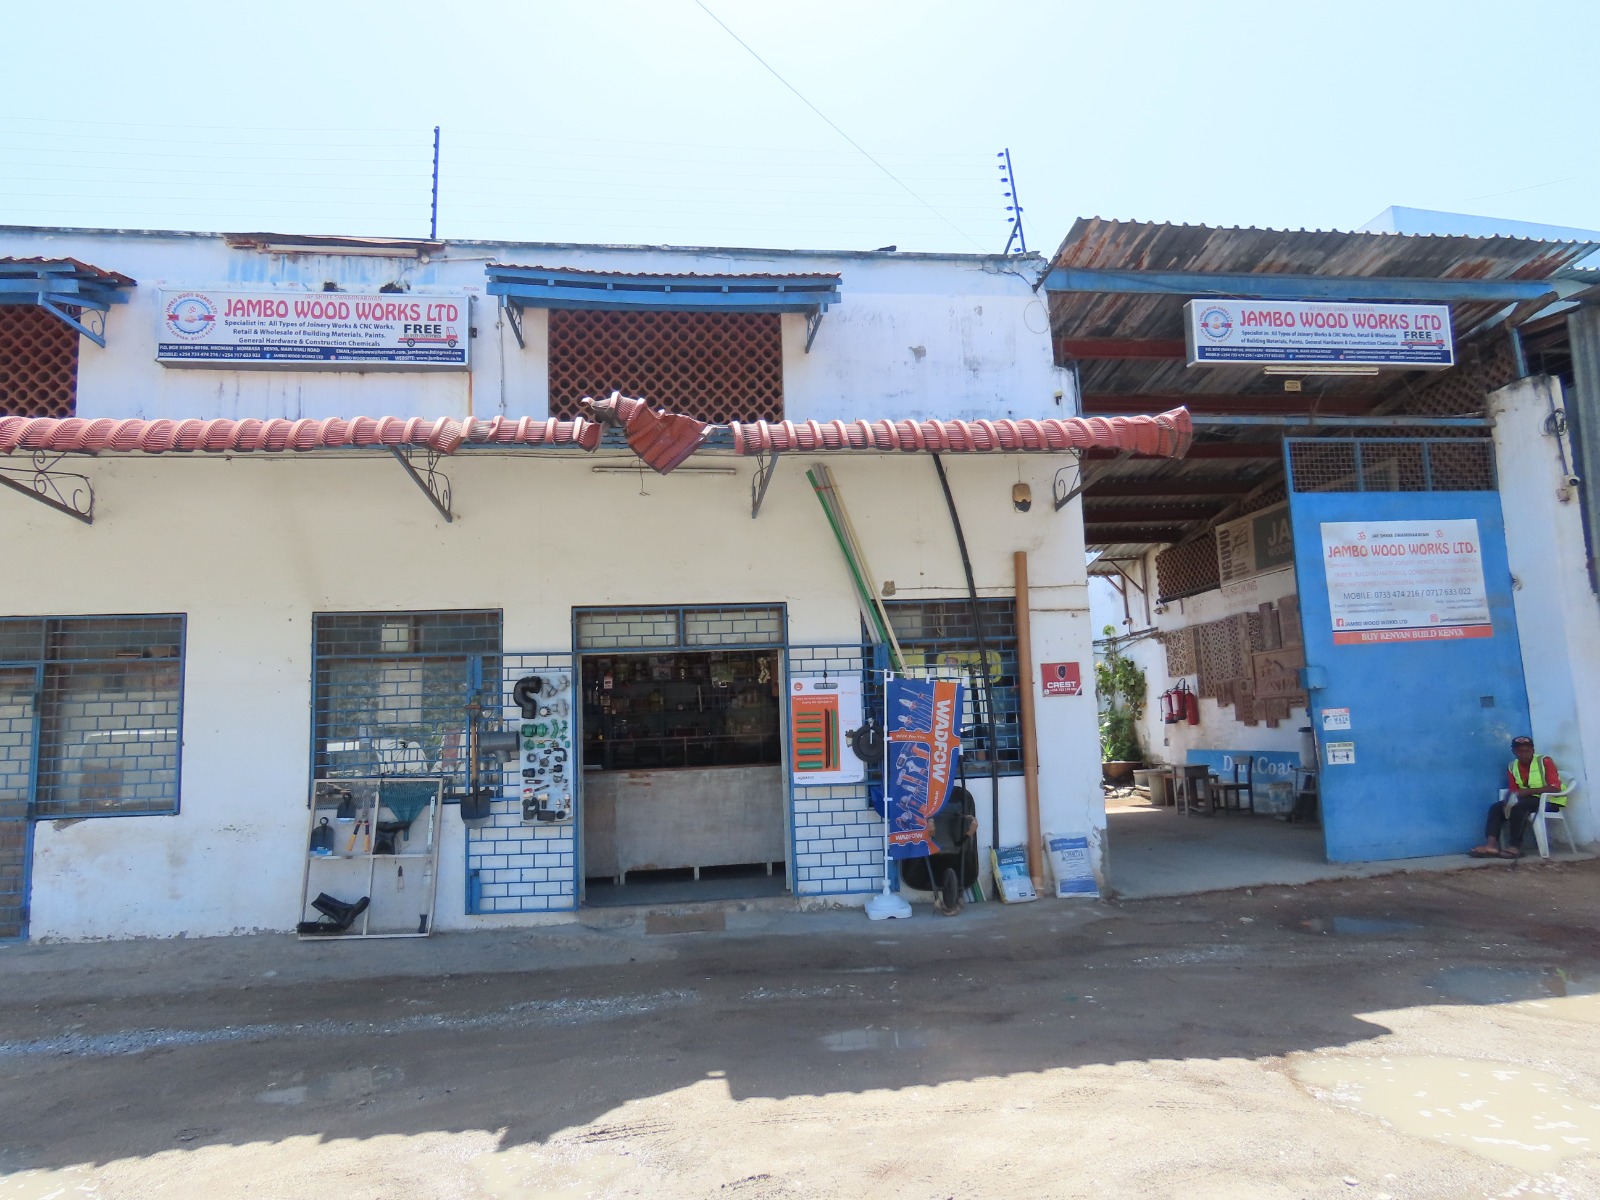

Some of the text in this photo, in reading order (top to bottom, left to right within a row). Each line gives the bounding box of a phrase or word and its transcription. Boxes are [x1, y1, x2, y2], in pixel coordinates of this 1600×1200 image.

[224, 298, 459, 322] JAMBO WOOD WORKS LTD
[224, 319, 257, 328] Specialist
[279, 321, 298, 329] Types
[306, 322, 331, 330] Joinery
[1239, 310, 1442, 330] JAMBO WOOD WORKS LTD
[302, 330, 331, 338] Building
[331, 331, 364, 339] Materials,
[404, 324, 442, 334] FREE
[1241, 330, 1263, 338] Specialist
[1403, 331, 1432, 340] FREE
[1219, 529, 1234, 582] NGUVU
[1328, 542, 1478, 558] JAMBO WOOD WORKS LTD.
[1344, 592, 1372, 600] MOBILE:
[1393, 590, 1405, 598] 474
[1406, 590, 1420, 598] 216
[1425, 588, 1444, 597] 0717
[1444, 588, 1458, 596] 633
[1458, 587, 1472, 596] 022
[1361, 628, 1465, 641] BUY KENYAN BUILD KENYA
[1047, 681, 1076, 689] CREST
[932, 699, 951, 784] WADFOW
[894, 832, 923, 841] WADFOW
